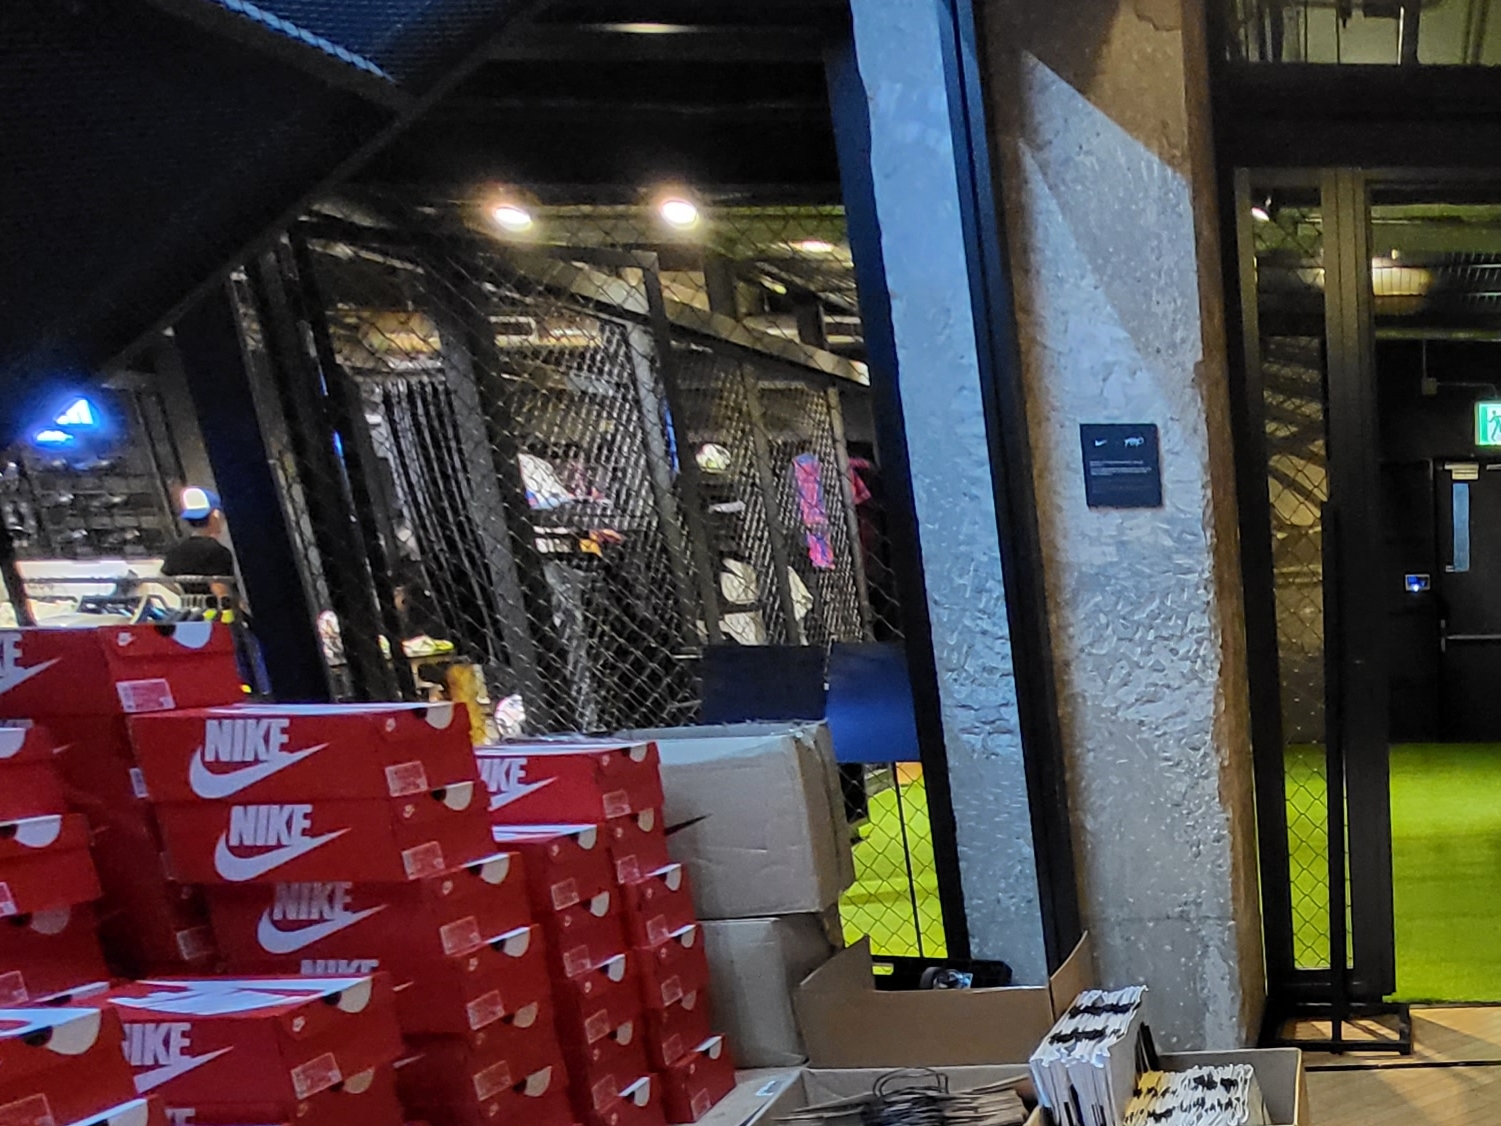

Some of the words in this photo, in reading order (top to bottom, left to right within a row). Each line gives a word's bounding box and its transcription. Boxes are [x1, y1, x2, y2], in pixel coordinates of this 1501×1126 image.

[204, 718, 290, 763] NIKE
[228, 804, 313, 847] NIKE
[272, 881, 353, 921] NIKE
